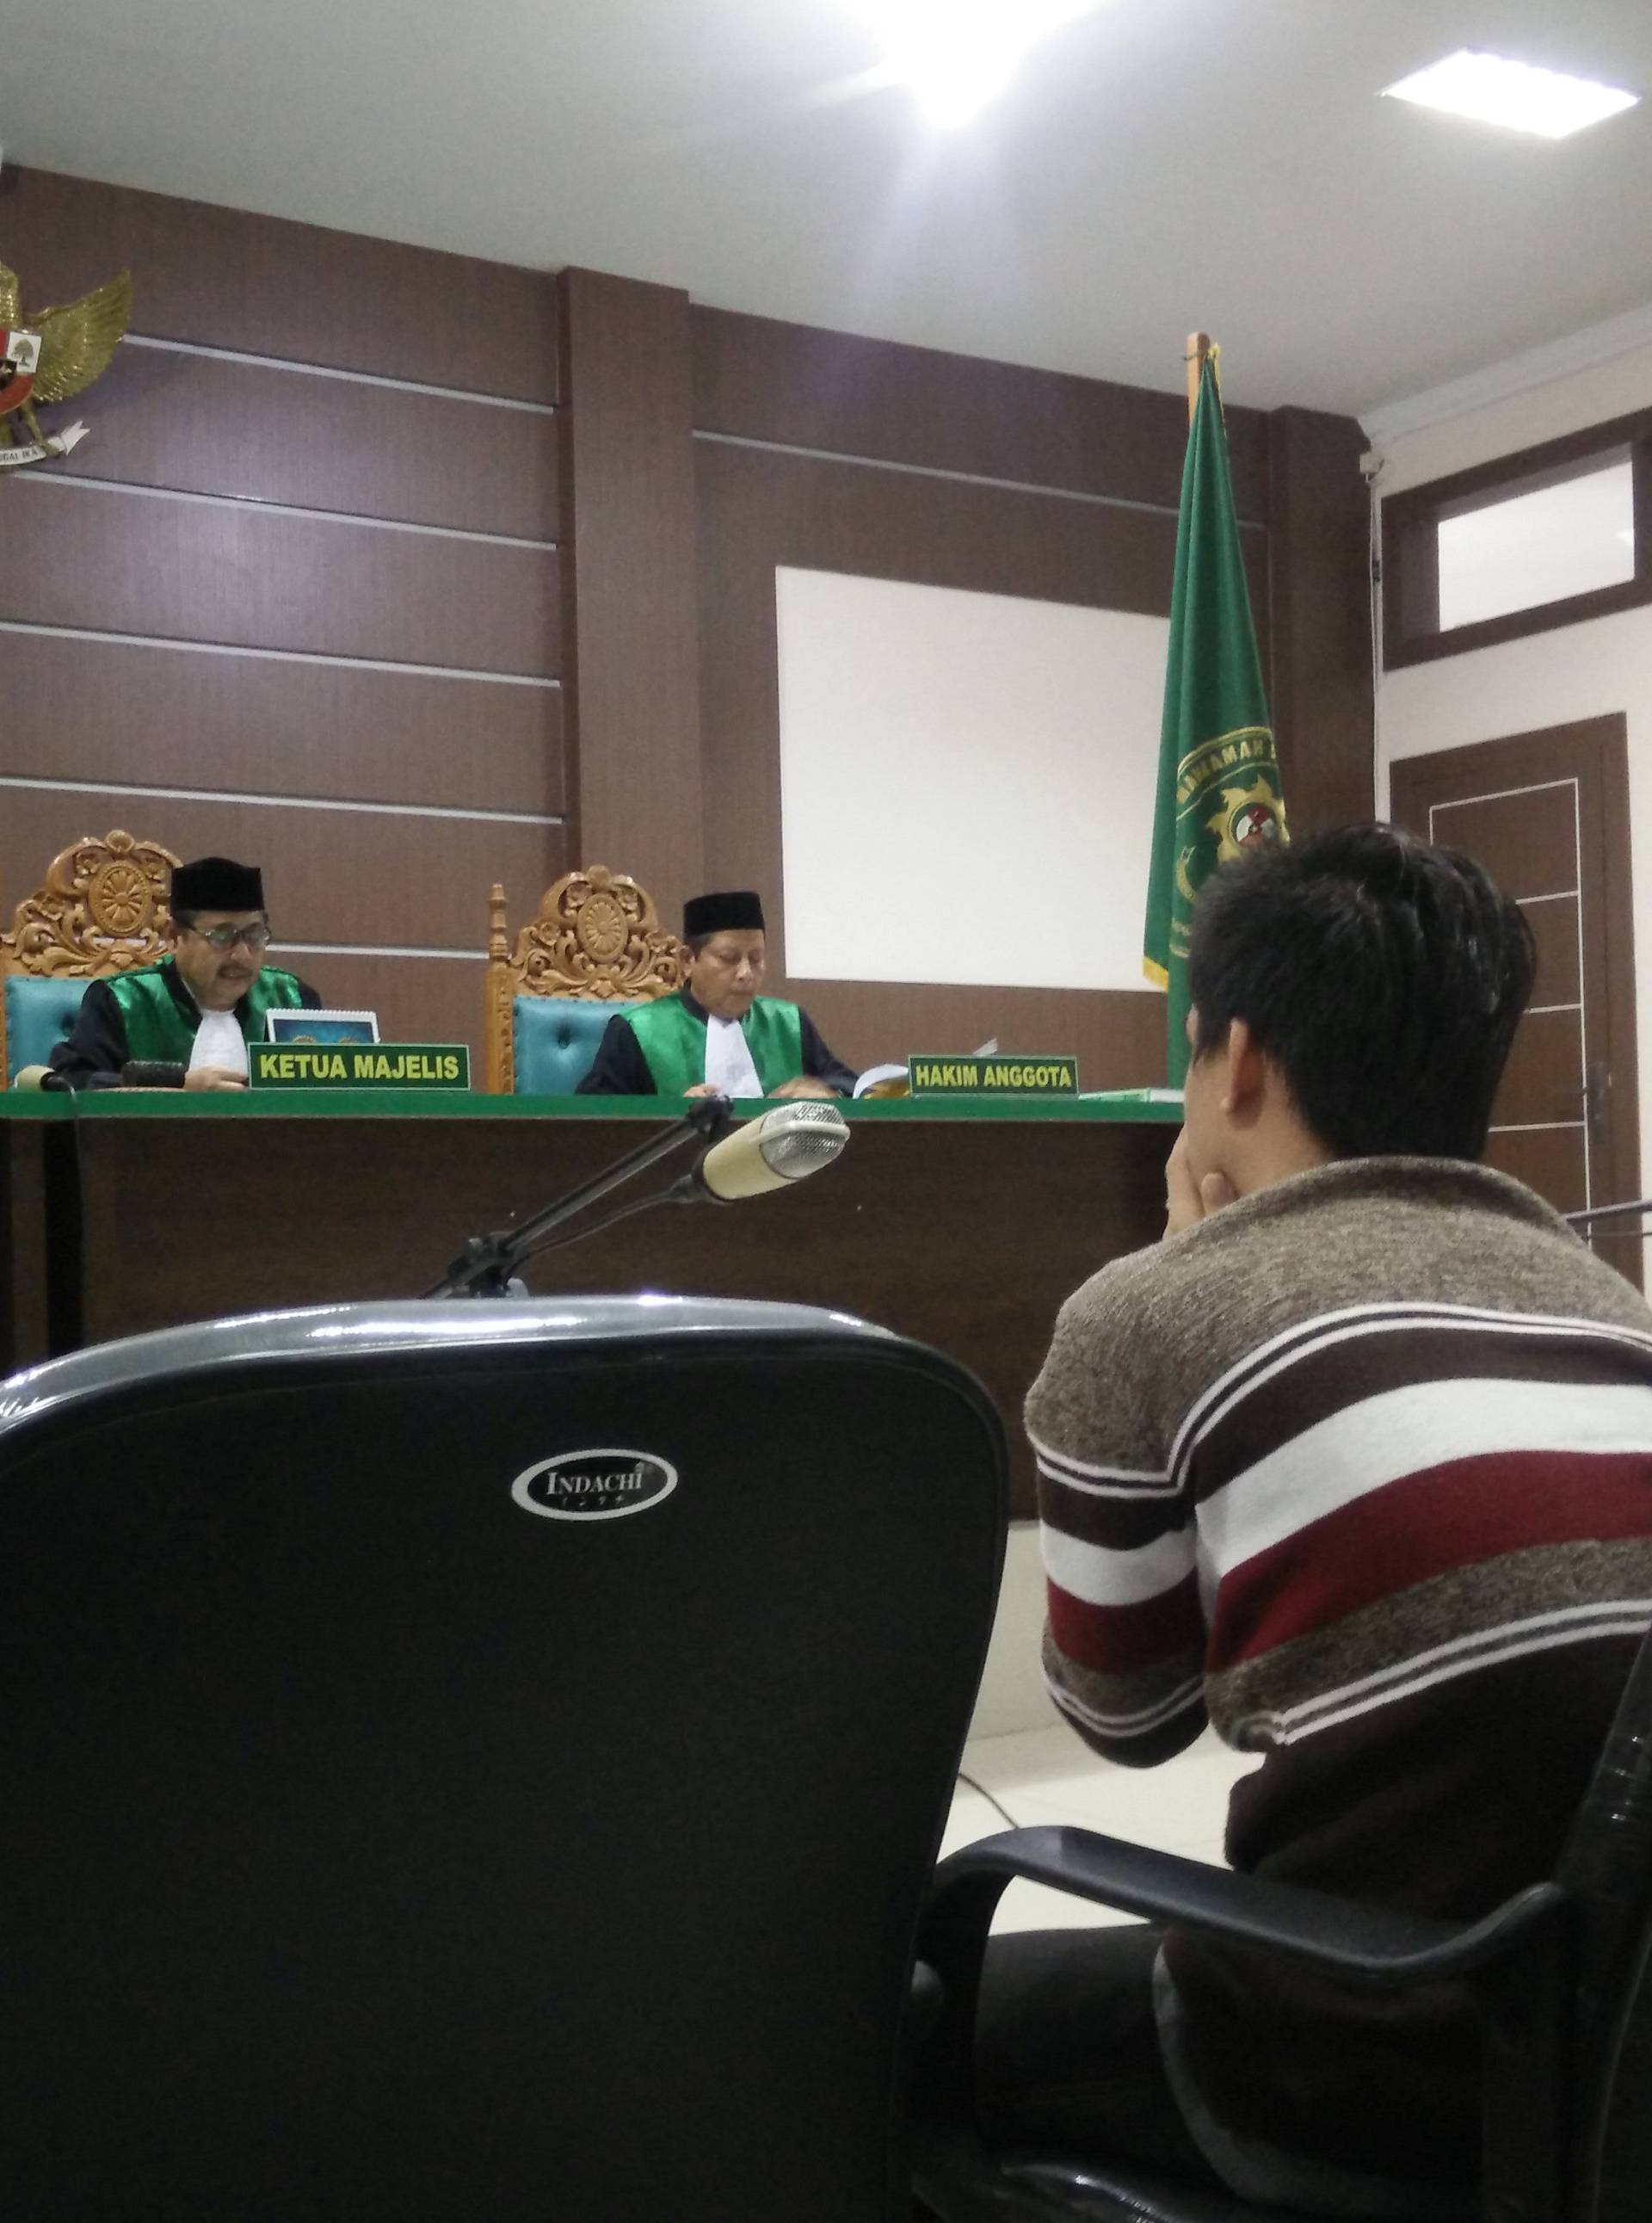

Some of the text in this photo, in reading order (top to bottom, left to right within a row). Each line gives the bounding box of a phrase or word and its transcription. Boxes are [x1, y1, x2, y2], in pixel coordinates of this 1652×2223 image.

[260, 1054, 459, 1079] KETUA MAJELIS
[915, 1065, 1072, 1088] HAKIM ANGGOTA
